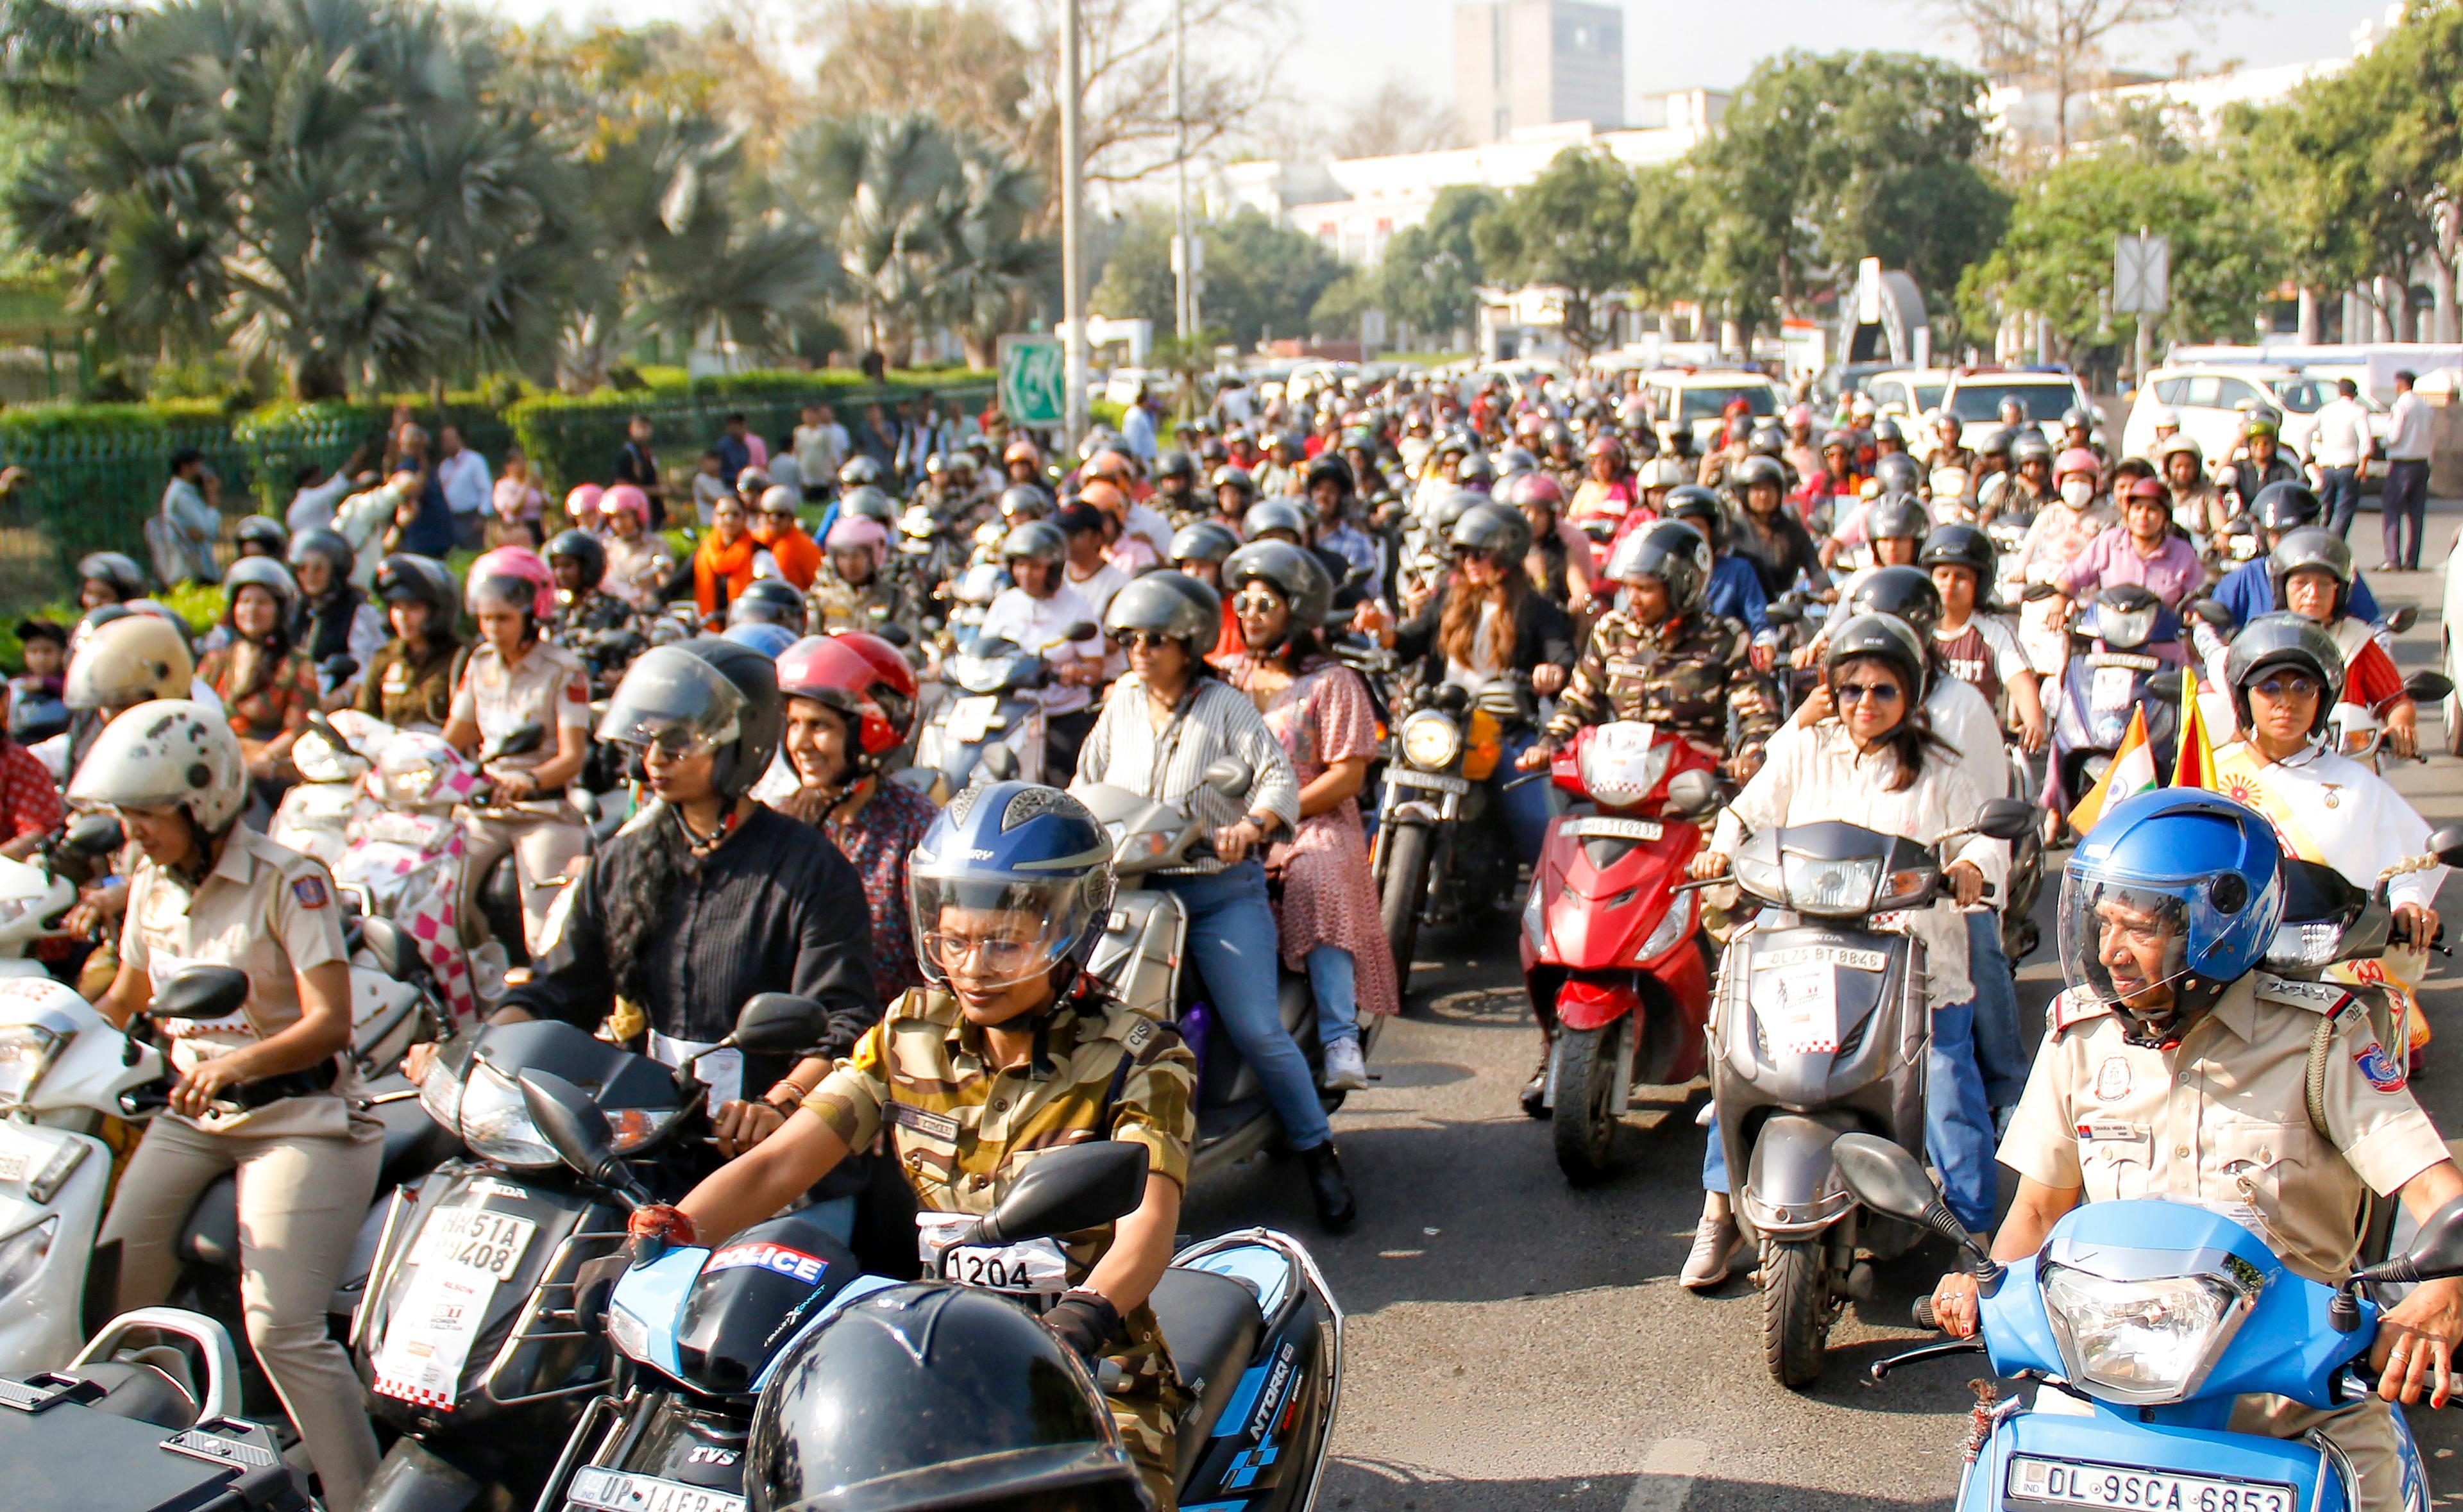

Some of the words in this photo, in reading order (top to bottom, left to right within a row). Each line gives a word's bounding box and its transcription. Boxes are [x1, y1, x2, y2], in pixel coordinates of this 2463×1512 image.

[1942, 659, 1985, 681] ENT
[1130, 1020, 1152, 1046] CIS
[706, 1246, 822, 1281] POLICE
[950, 1251, 1033, 1289] 1204
[1249, 1359, 1289, 1441] NTORQ
[688, 1445, 741, 1466] TVS
[598, 1476, 632, 1506] UP
[2023, 1483, 2040, 1493] IND
[2048, 1466, 2085, 1498] DL
[2103, 1475, 2181, 1511] 9SCA
[2201, 1486, 2281, 1512] 6853
